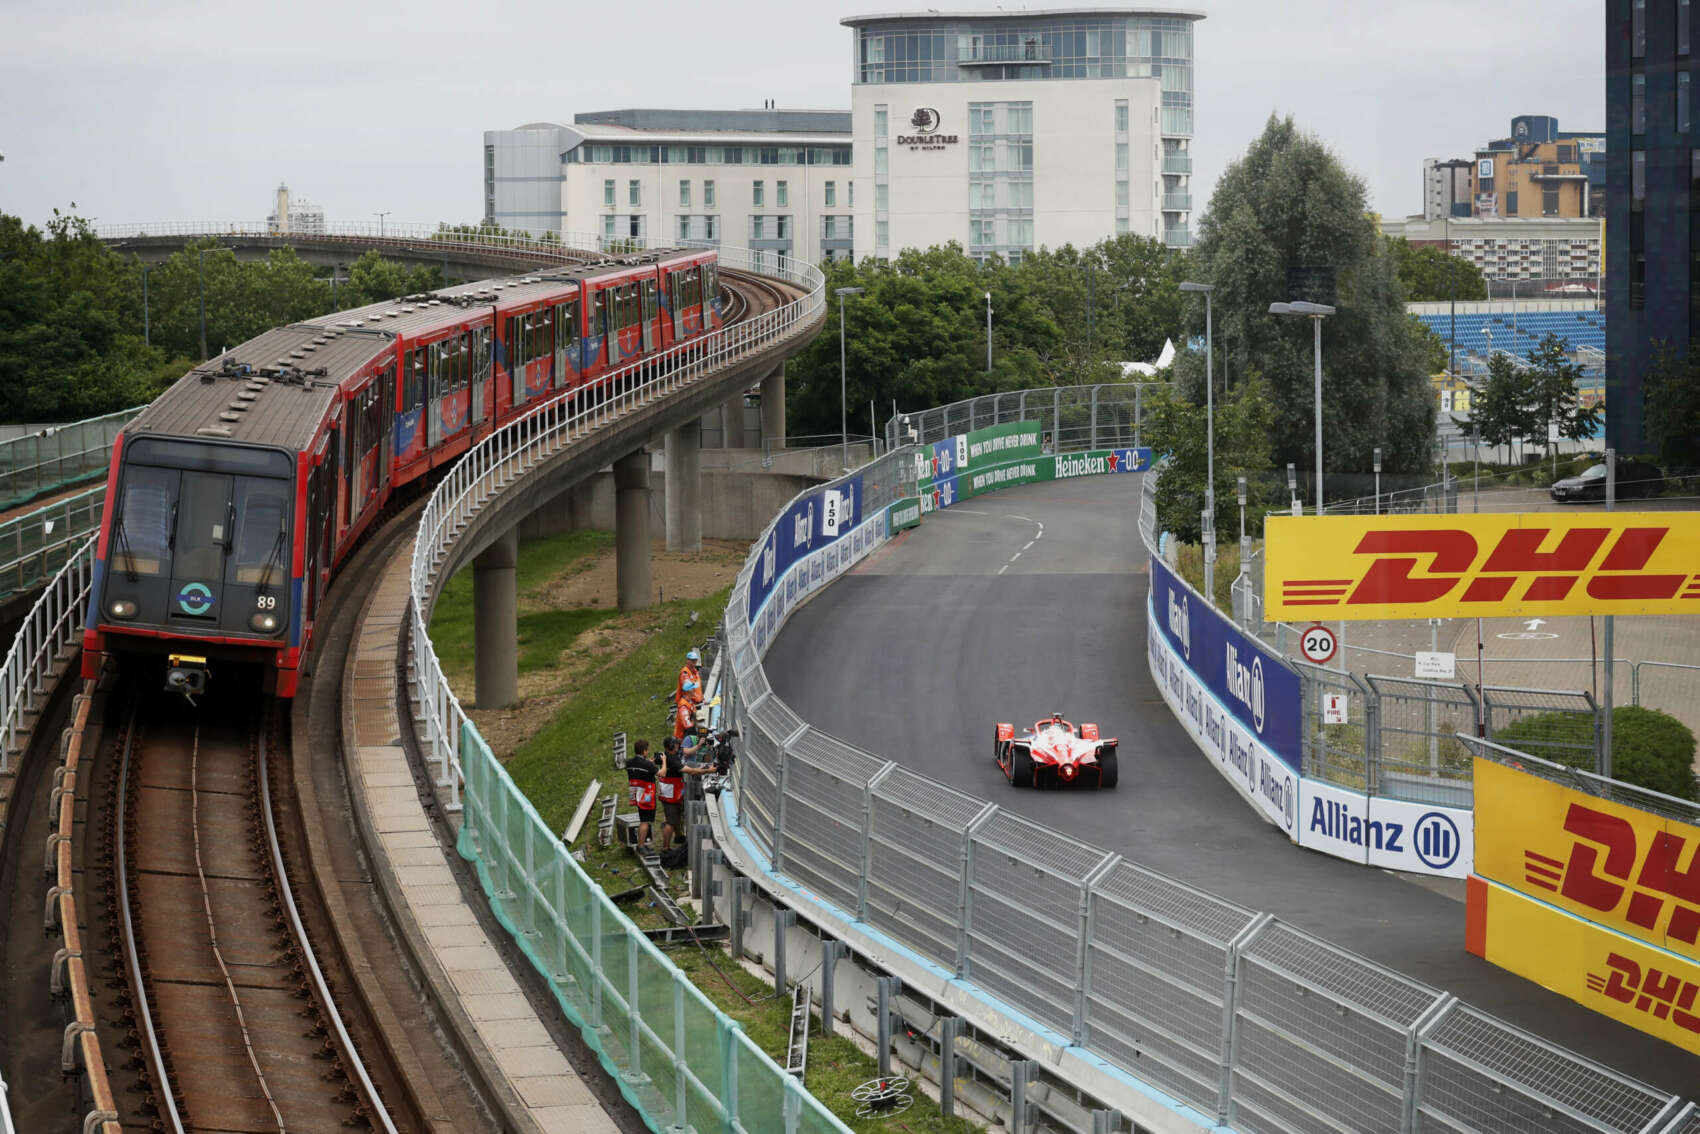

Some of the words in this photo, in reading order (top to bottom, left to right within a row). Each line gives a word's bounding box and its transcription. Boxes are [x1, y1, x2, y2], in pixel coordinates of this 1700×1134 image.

[1055, 453, 1105, 478] Heineken
[1345, 528, 1688, 604] DHL
[257, 596, 275, 610] 89
[1307, 638, 1330, 652] 20
[1206, 704, 1220, 748] Allianz
[1230, 730, 1247, 777] Allianz
[1260, 758, 1283, 812] Allianz
[1310, 796, 1403, 853] Allianz
[1603, 952, 1700, 1034] DHL
